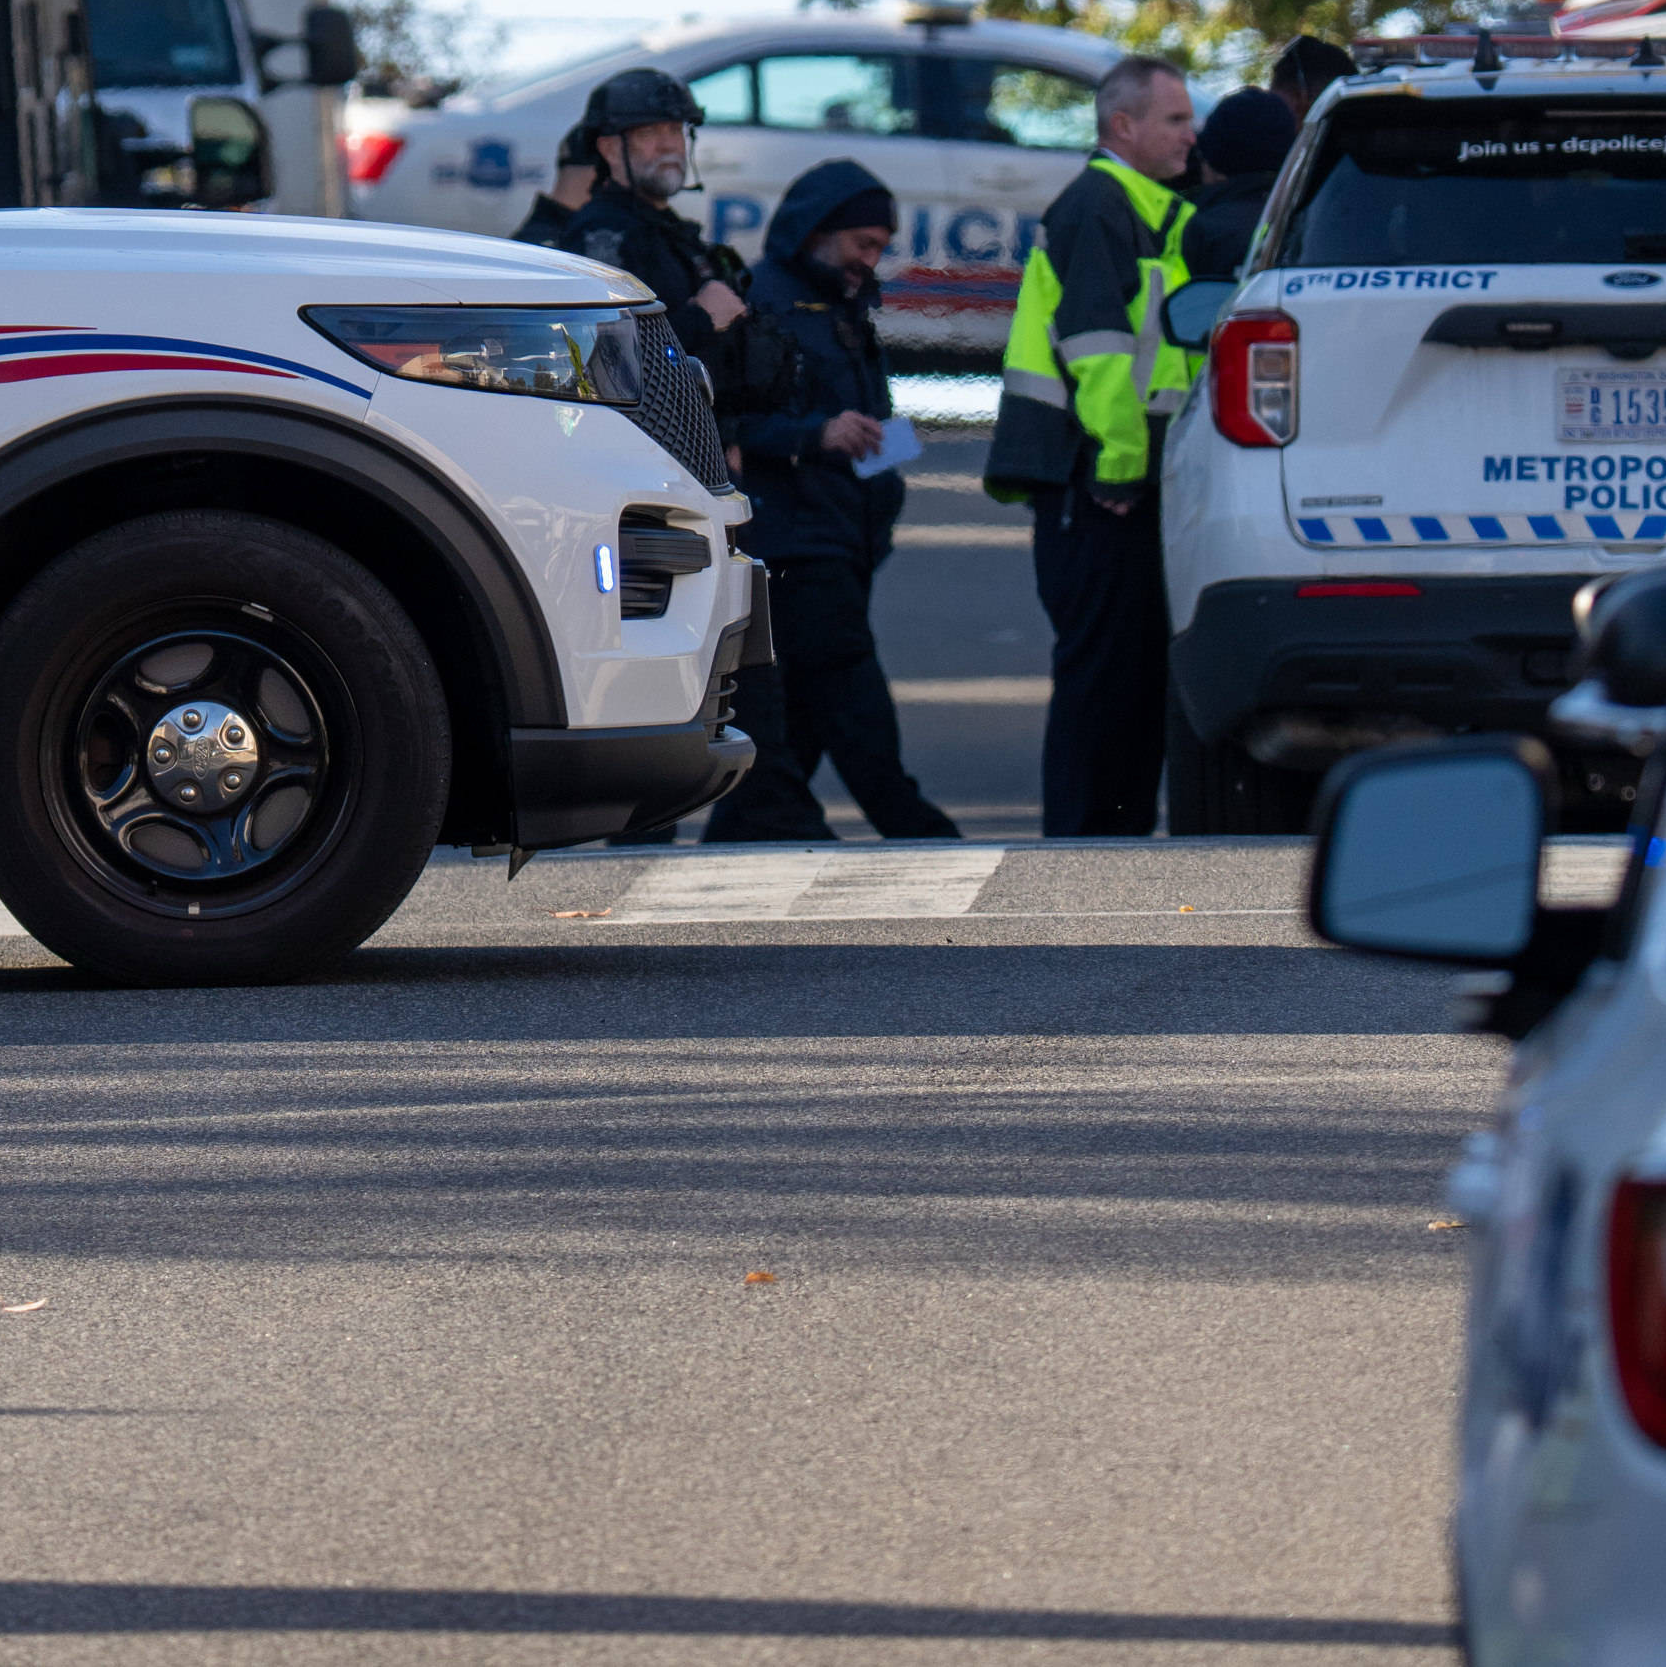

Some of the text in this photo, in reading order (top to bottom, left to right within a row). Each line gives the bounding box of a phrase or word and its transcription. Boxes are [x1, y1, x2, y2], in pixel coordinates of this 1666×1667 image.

[1458, 140, 1507, 162] Join
[1514, 140, 1540, 155] us
[1334, 270, 1498, 290] DISTRICT
